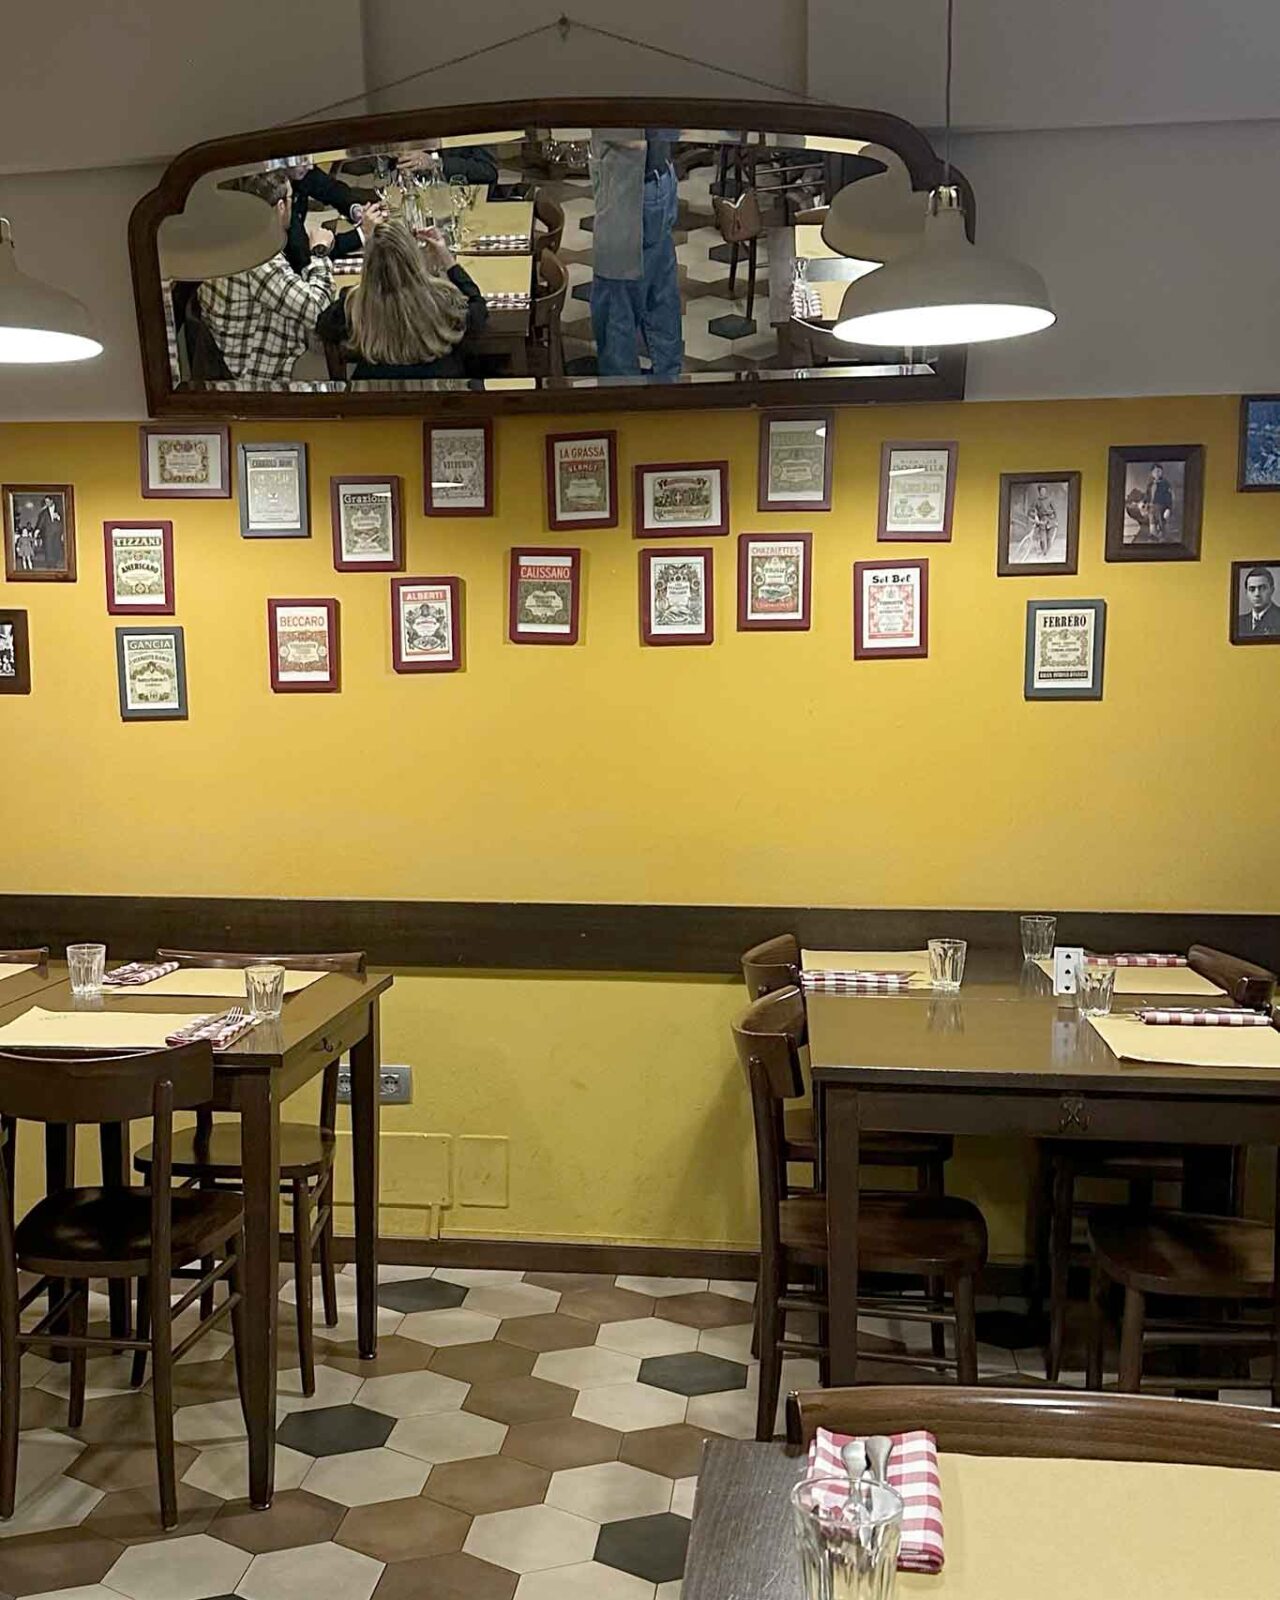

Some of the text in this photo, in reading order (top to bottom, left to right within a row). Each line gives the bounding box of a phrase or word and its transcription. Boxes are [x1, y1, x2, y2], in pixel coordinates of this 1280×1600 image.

[560, 445, 605, 459] LA GRASSA
[121, 562, 160, 574] AMERICANO
[520, 566, 570, 579] CALISSANO
[279, 615, 325, 627] BECCARO
[1042, 614, 1087, 628] FERRERO
[129, 639, 171, 649] GANCIA
